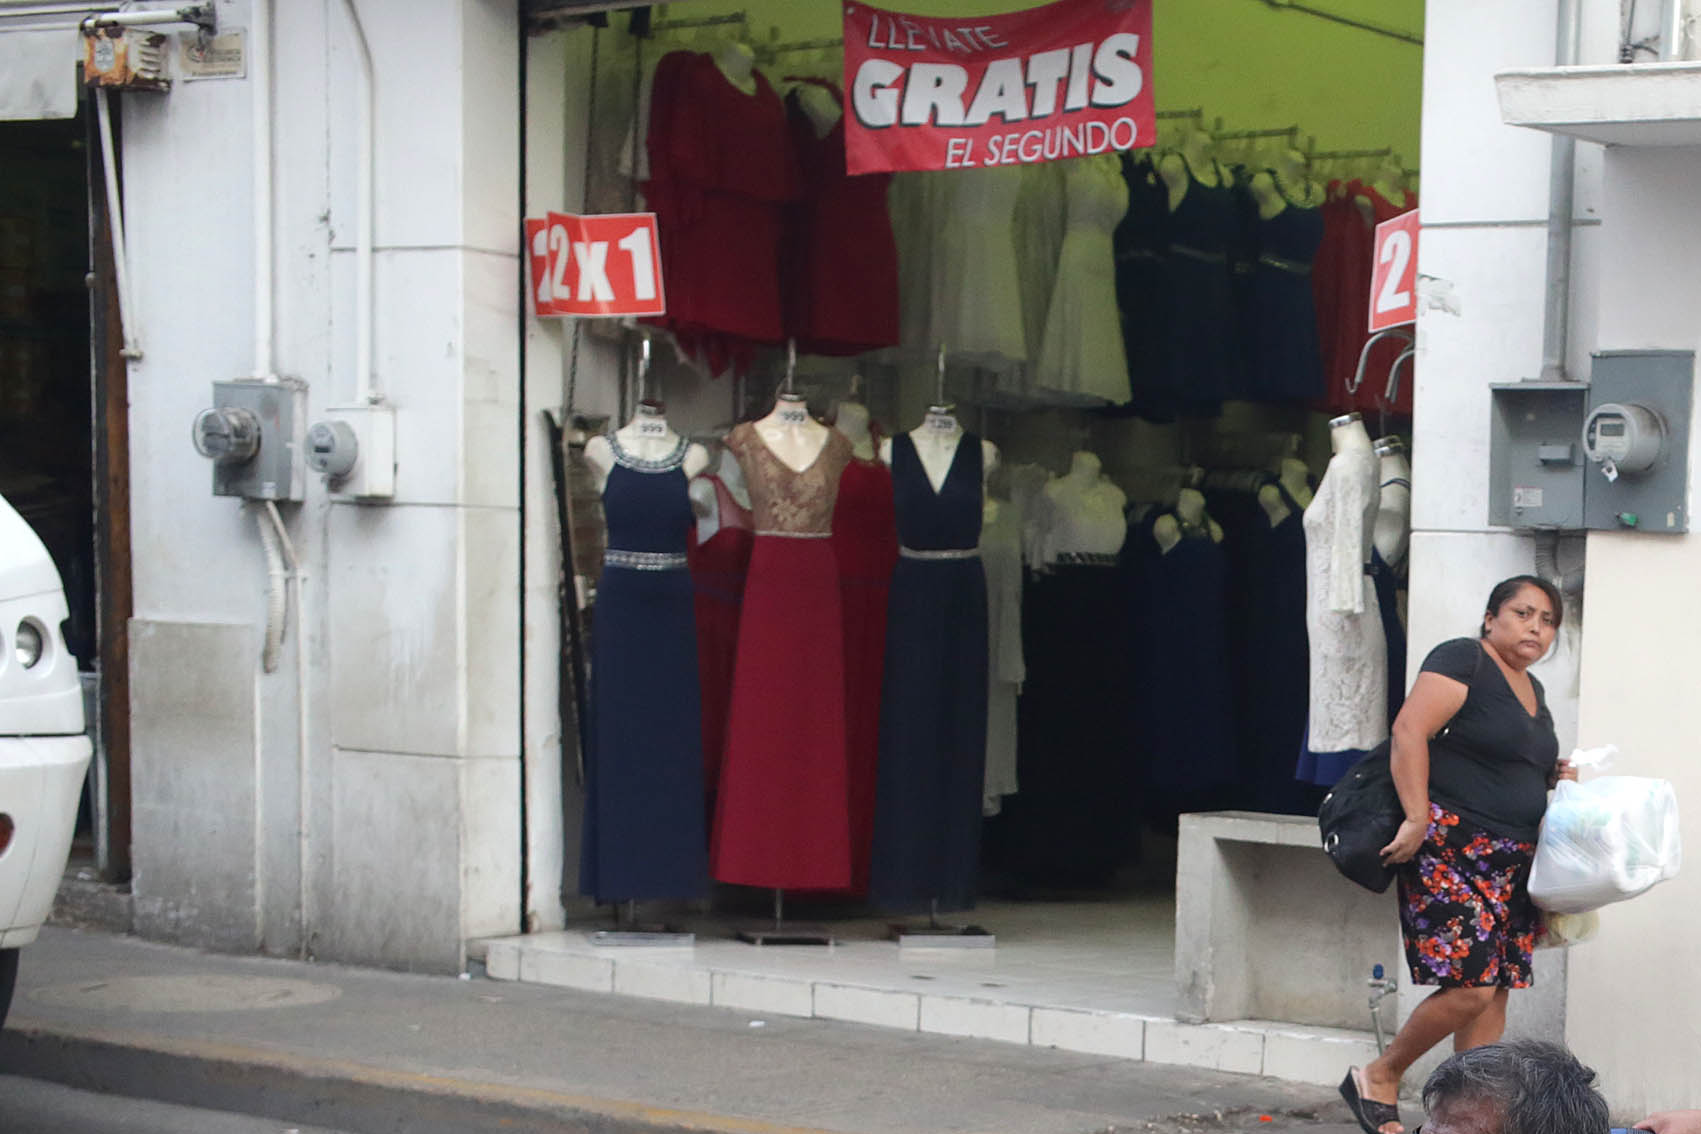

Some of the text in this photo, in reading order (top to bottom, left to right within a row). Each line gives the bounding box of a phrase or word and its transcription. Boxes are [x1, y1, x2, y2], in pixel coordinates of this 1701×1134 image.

[853, 33, 1143, 128] GRATIS
[945, 117, 1138, 168] EL SEGUNDO
[1377, 229, 1412, 313] 2
